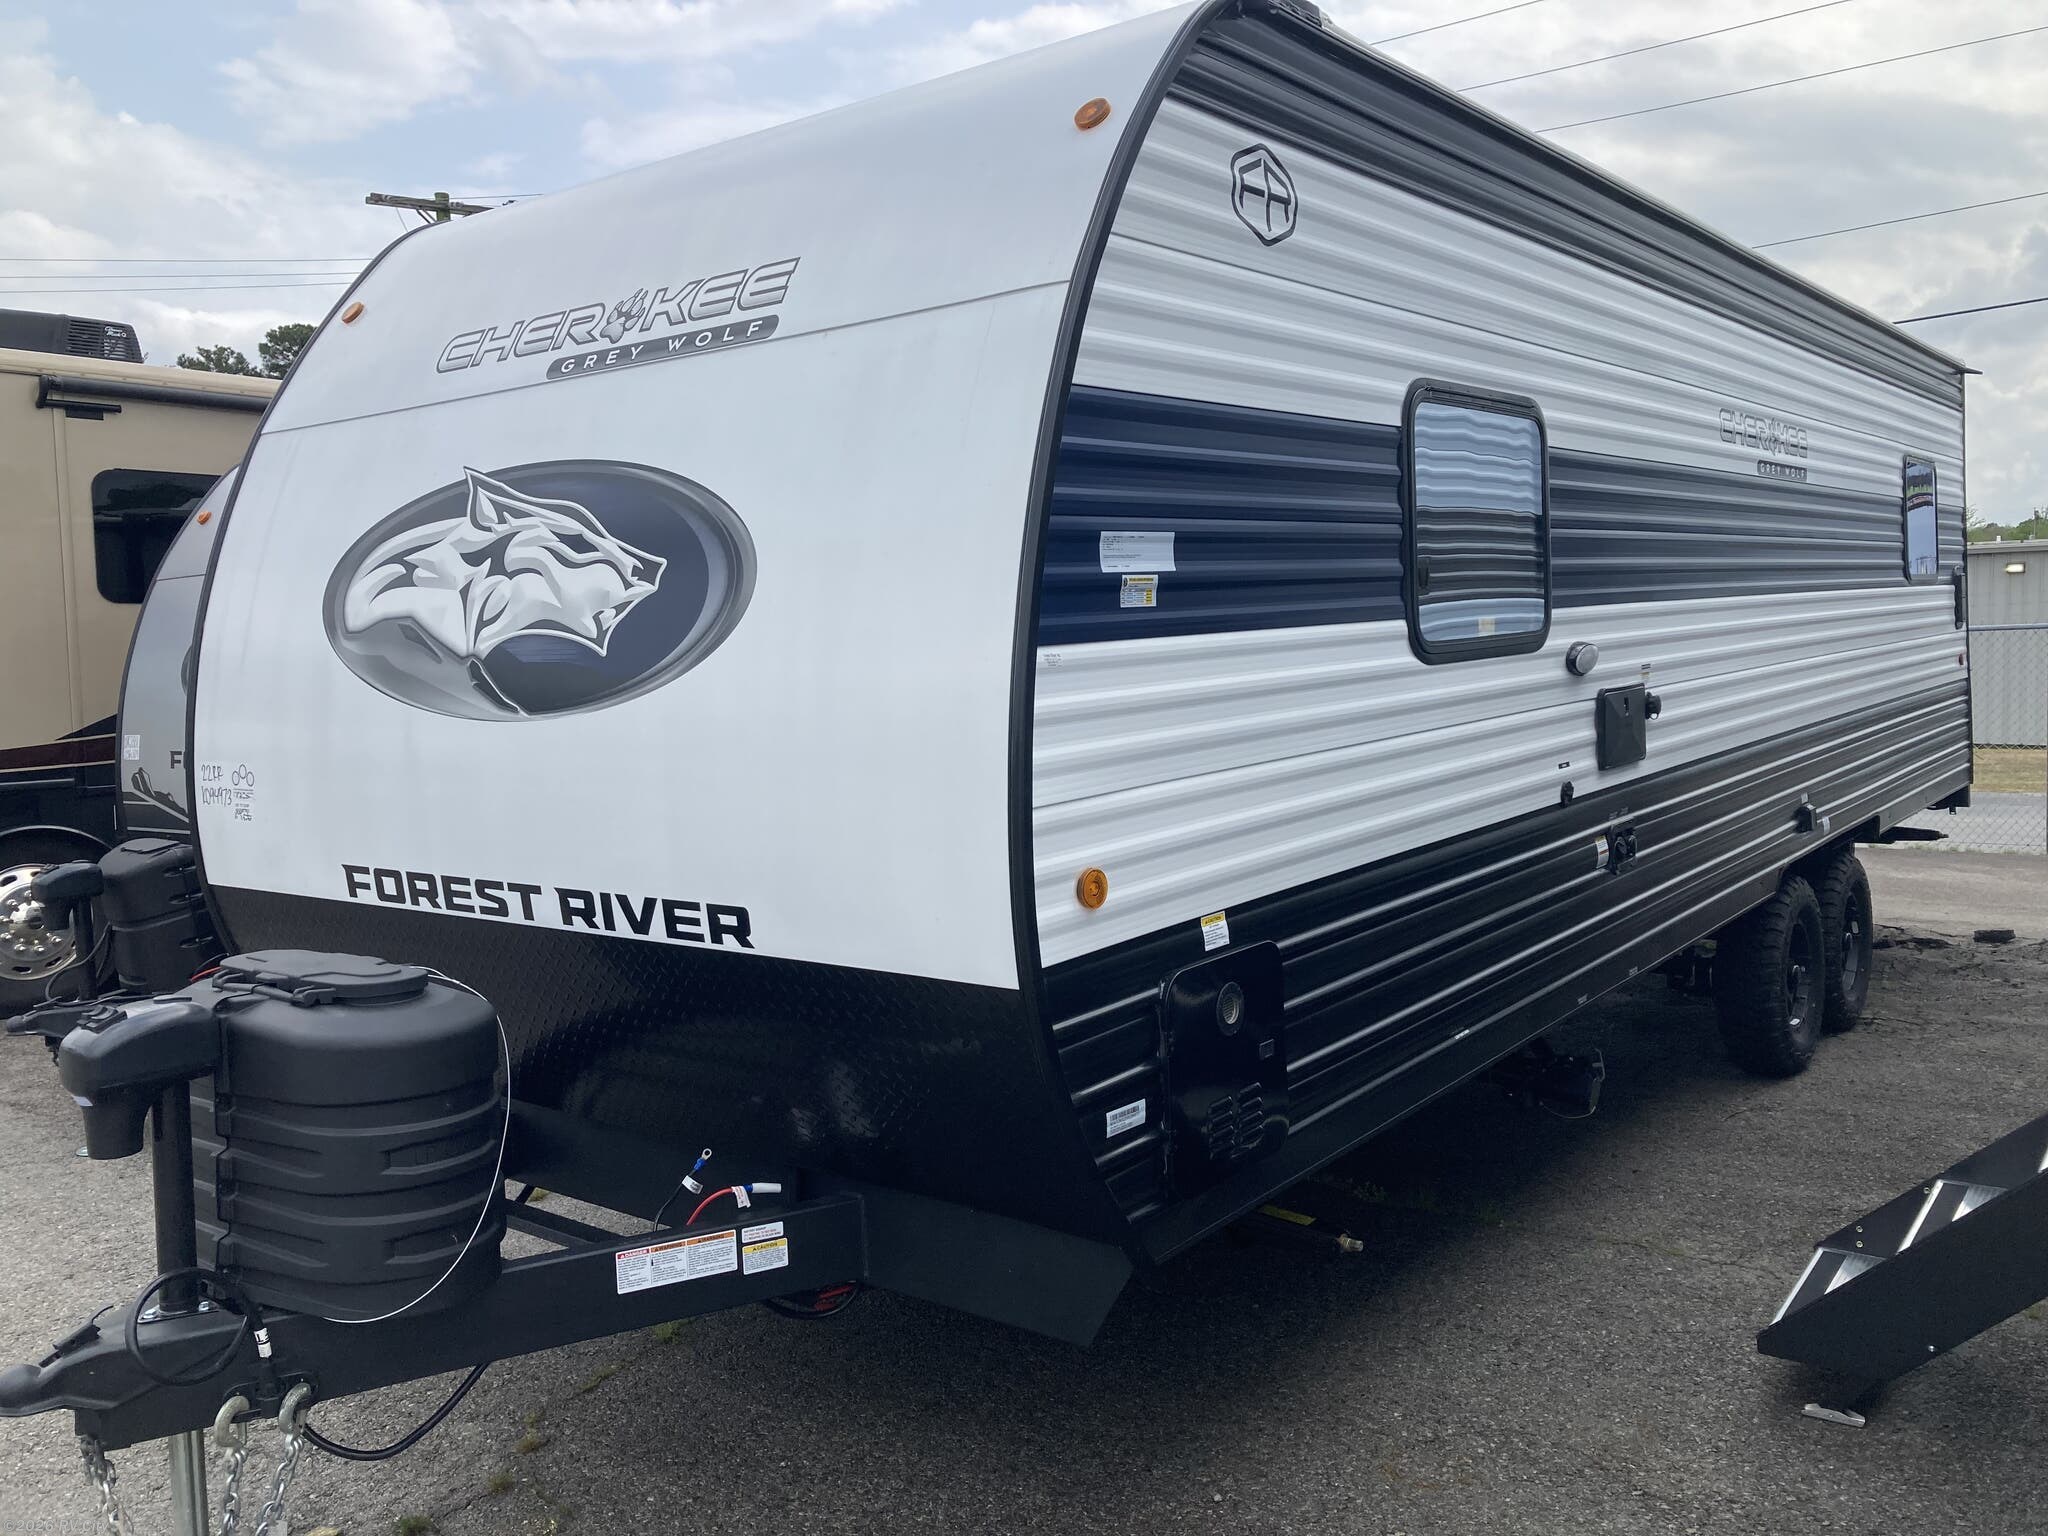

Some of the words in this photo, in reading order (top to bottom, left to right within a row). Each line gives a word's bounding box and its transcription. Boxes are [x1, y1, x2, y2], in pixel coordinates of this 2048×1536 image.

[560, 344, 644, 374] GREY
[667, 320, 764, 351] WOLF
[1760, 463, 1780, 477] GREY
[1785, 467, 1806, 479] WOLF
[341, 863, 542, 922] FOREST
[553, 886, 755, 949] RIVER
[757, 1241, 778, 1251] CAUTION
